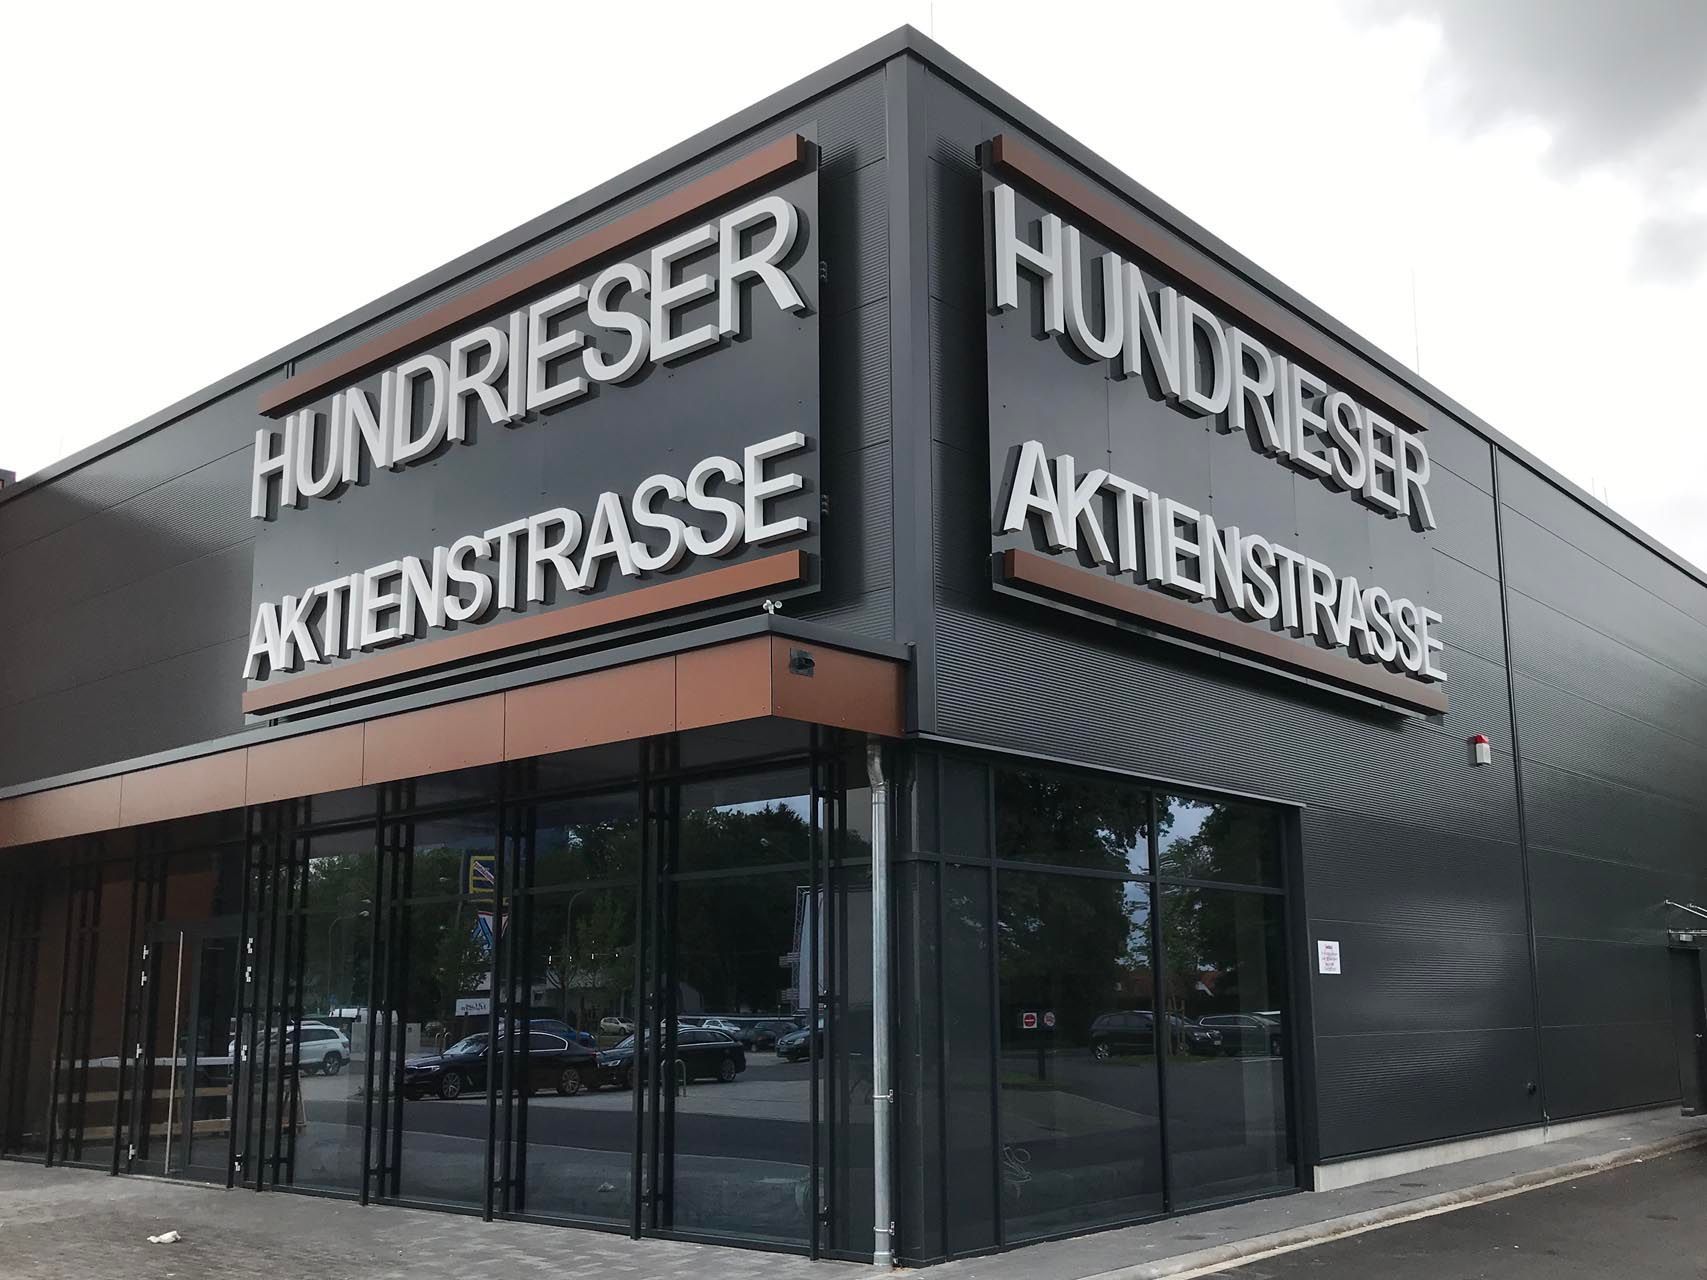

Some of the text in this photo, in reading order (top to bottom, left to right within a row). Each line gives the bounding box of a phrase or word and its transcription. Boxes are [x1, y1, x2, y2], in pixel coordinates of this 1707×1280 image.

[250, 196, 806, 519] HUNDRIESER
[994, 183, 1437, 530] HUNDRIESER
[243, 431, 808, 679] AKTIENSTRASSE
[1003, 440, 1447, 682] AKTIENSTRASSE
